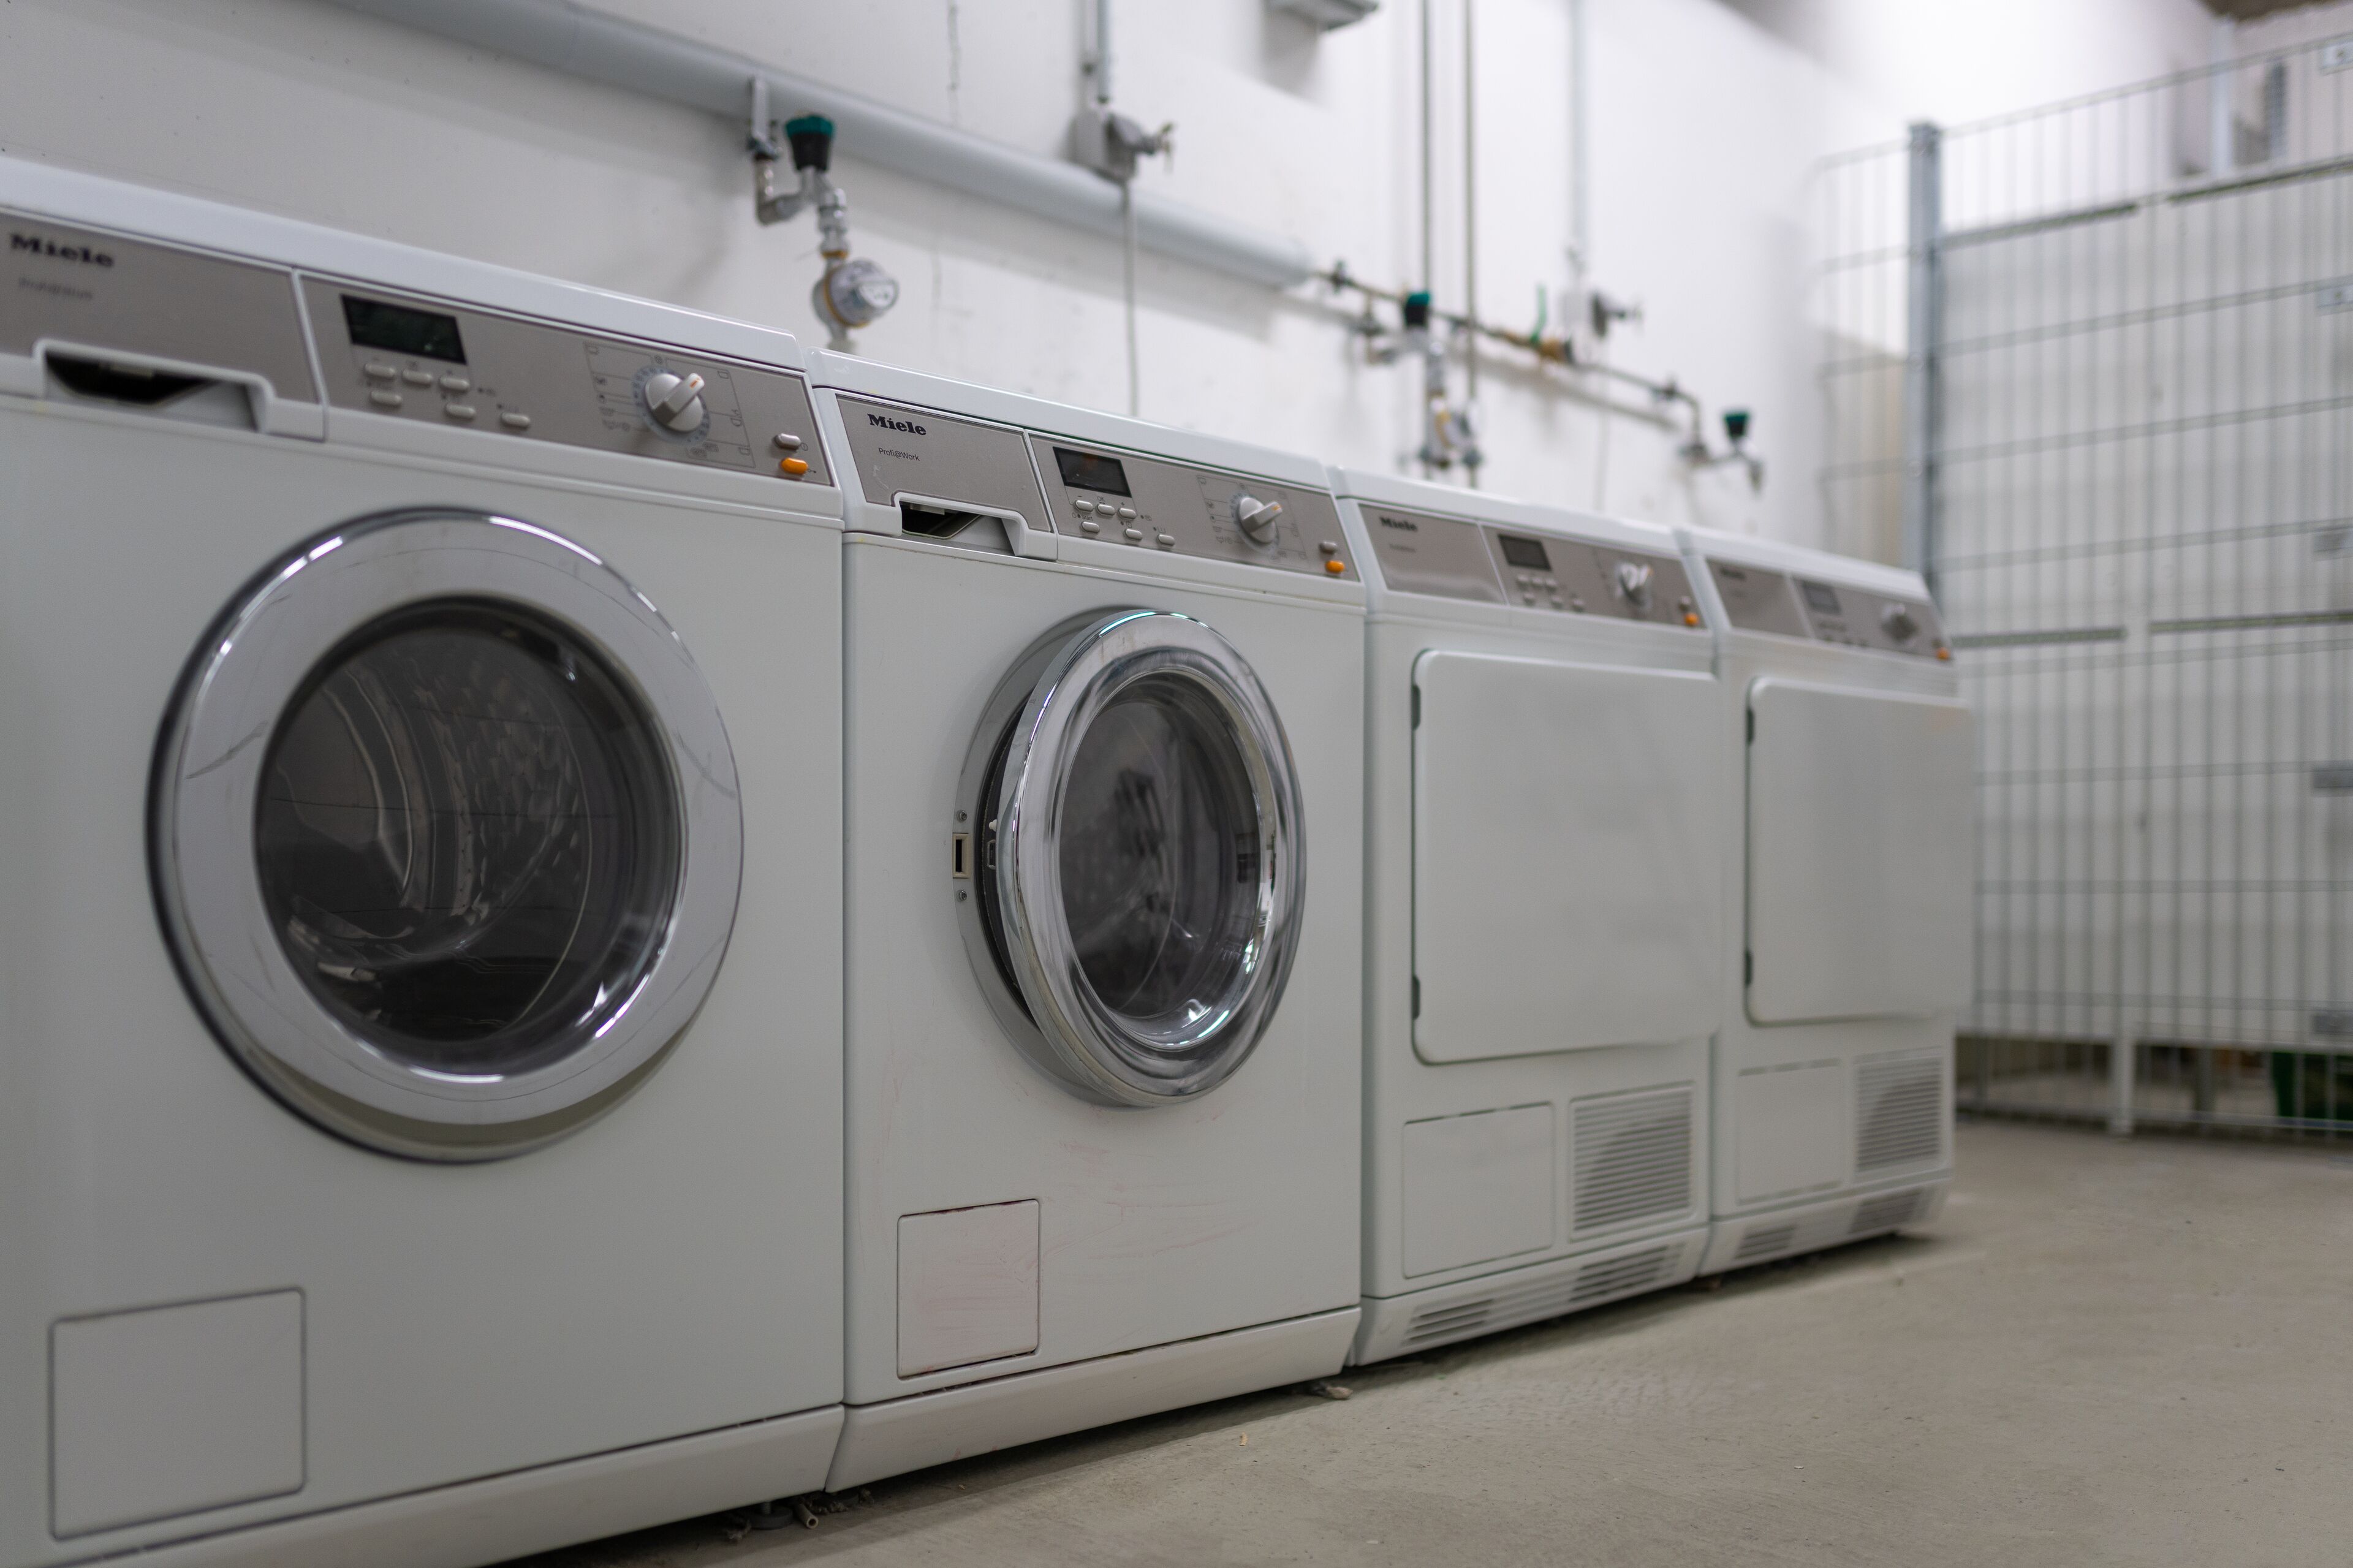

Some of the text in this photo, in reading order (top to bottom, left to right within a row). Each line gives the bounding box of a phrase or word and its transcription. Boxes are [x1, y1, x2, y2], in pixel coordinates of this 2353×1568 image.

[11, 233, 115, 267] Miele
[867, 413, 926, 436] Miele
[878, 447, 920, 461] Profi@Work
[1379, 517, 1419, 532] Miele
